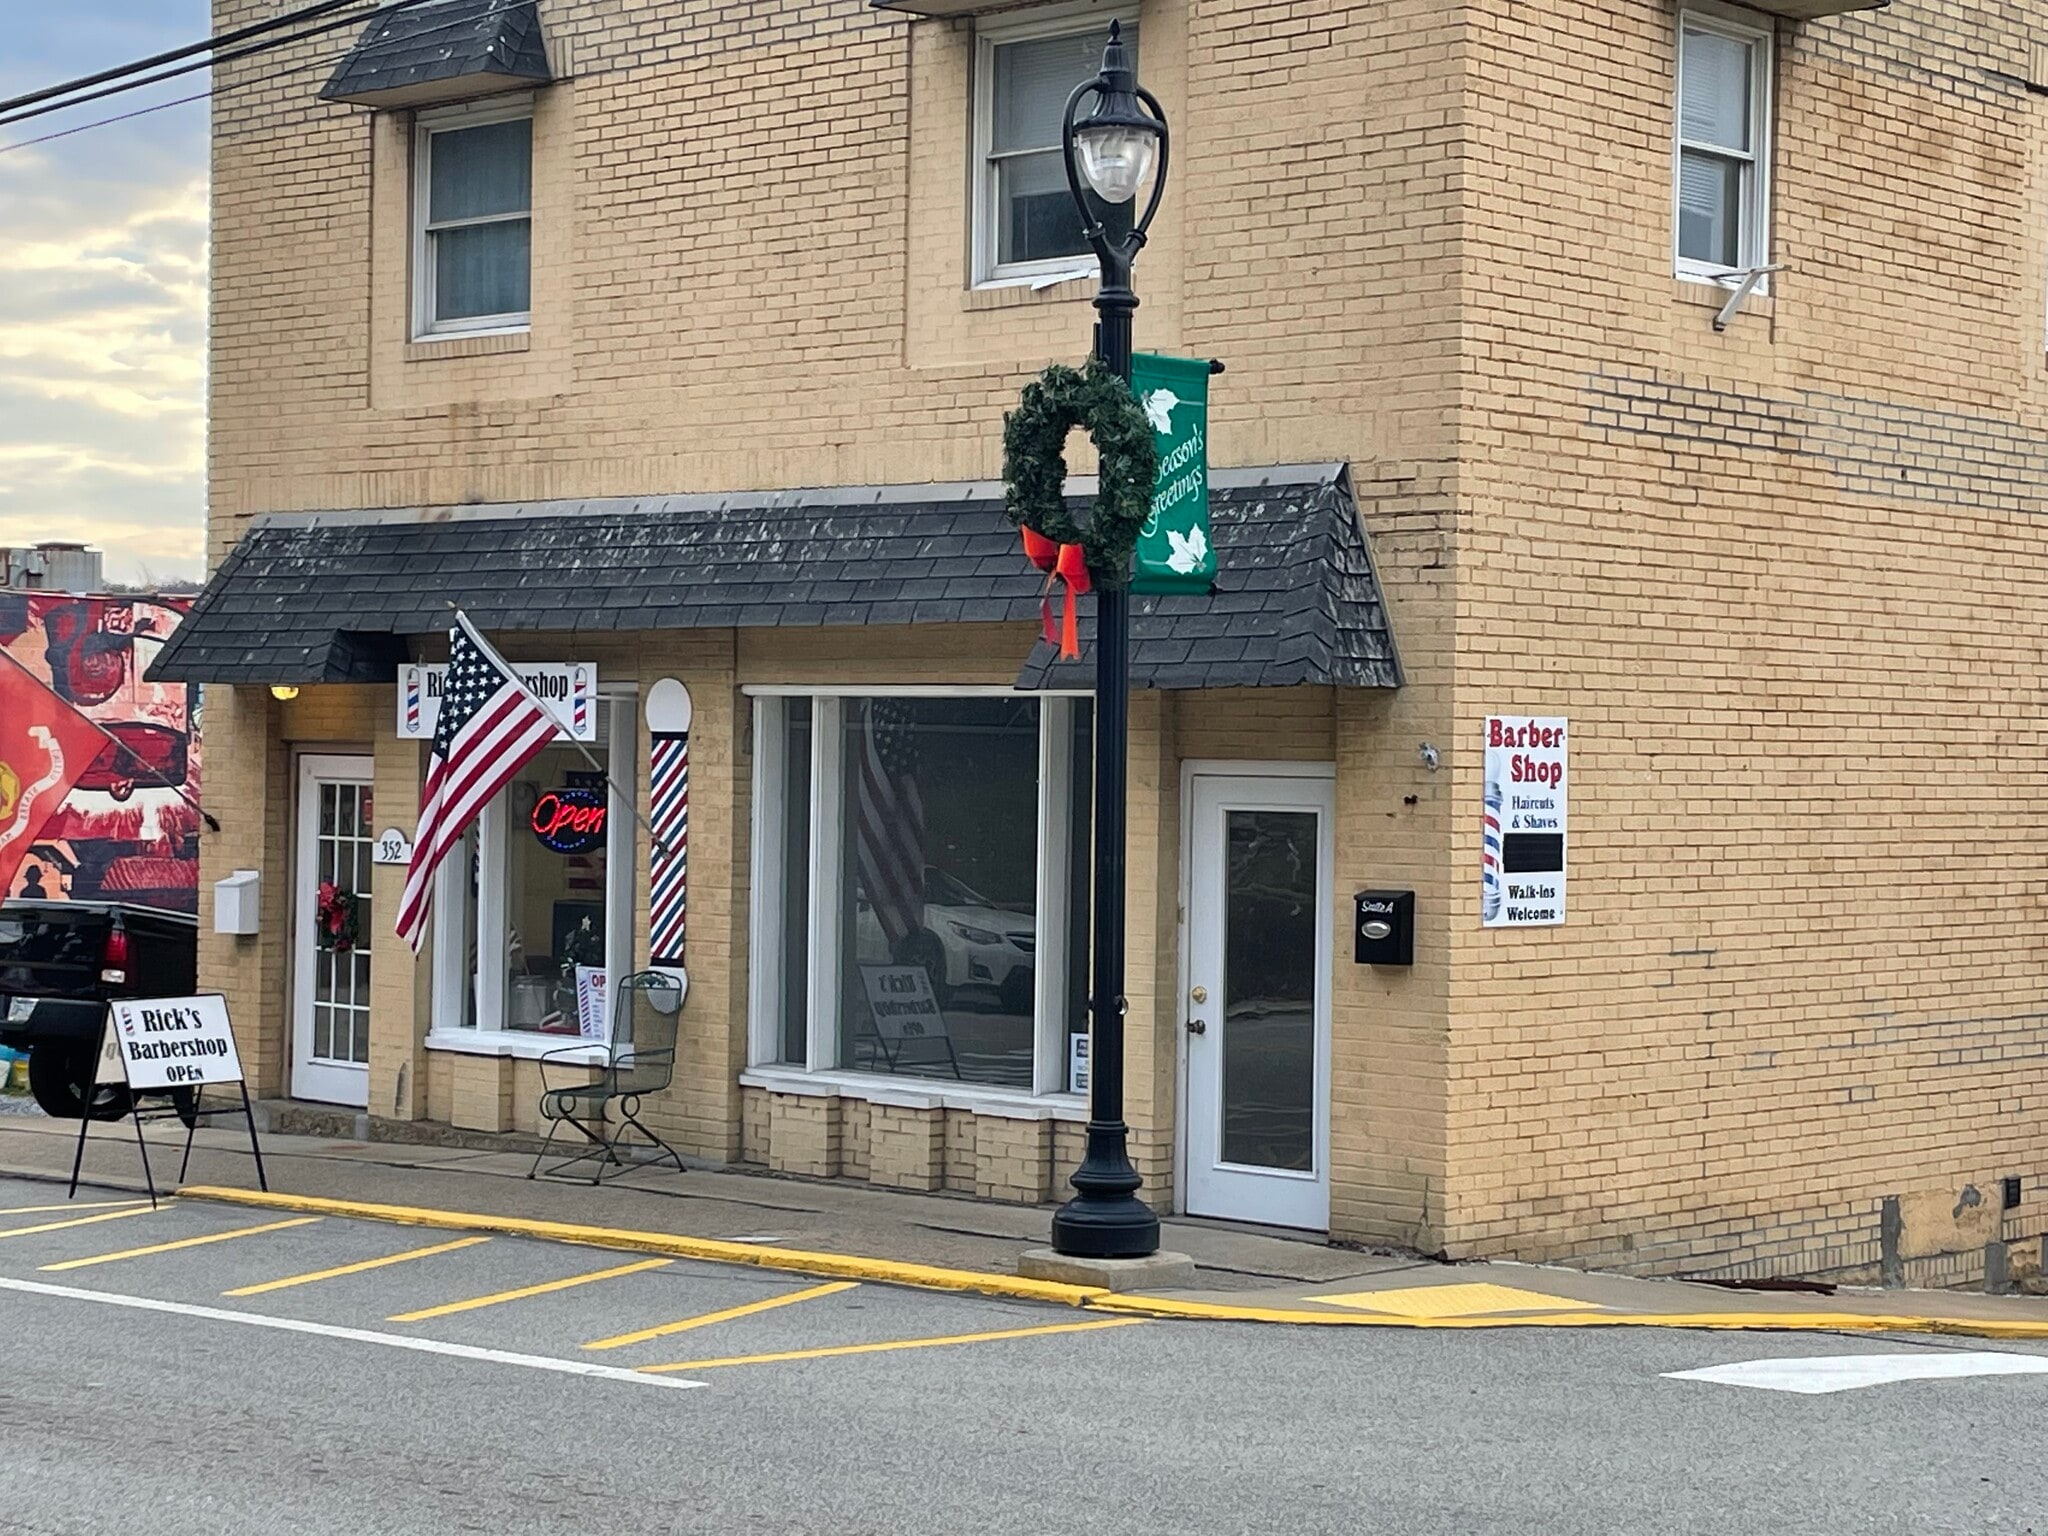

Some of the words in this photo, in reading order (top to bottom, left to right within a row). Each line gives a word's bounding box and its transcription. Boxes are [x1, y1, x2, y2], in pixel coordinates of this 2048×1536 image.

[1489, 718, 1564, 748] Barber
[1511, 754, 1563, 789] Shop
[1511, 796, 1555, 810] Haircuts
[531, 792, 606, 837] Open
[1511, 815, 1520, 828] &
[1523, 814, 1558, 828] Shaves
[382, 841, 402, 861] 352
[1507, 907, 1556, 921] Welcome
[141, 1007, 203, 1032] Rick's
[127, 1038, 228, 1060] Barbershop
